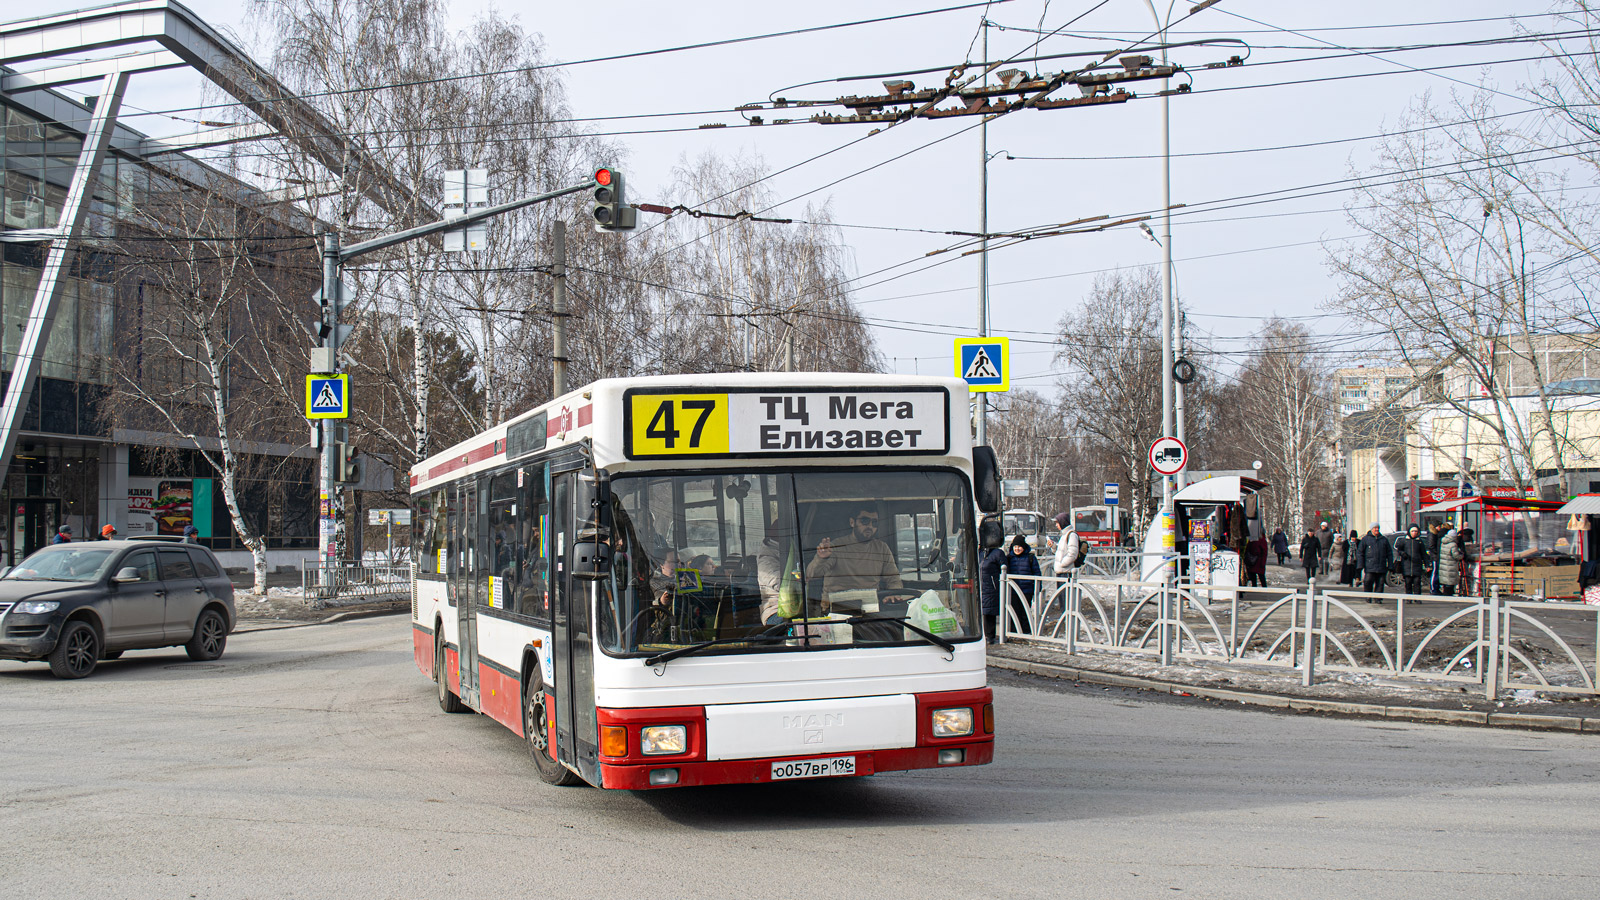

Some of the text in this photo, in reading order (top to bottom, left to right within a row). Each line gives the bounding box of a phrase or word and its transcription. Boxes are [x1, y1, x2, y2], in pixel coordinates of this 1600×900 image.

[759, 396, 914, 425] ТЦ Мега
[645, 399, 716, 449] 47
[759, 424, 922, 450] Елизавет
[783, 712, 844, 729] MAN
[831, 758, 851, 770] 196
